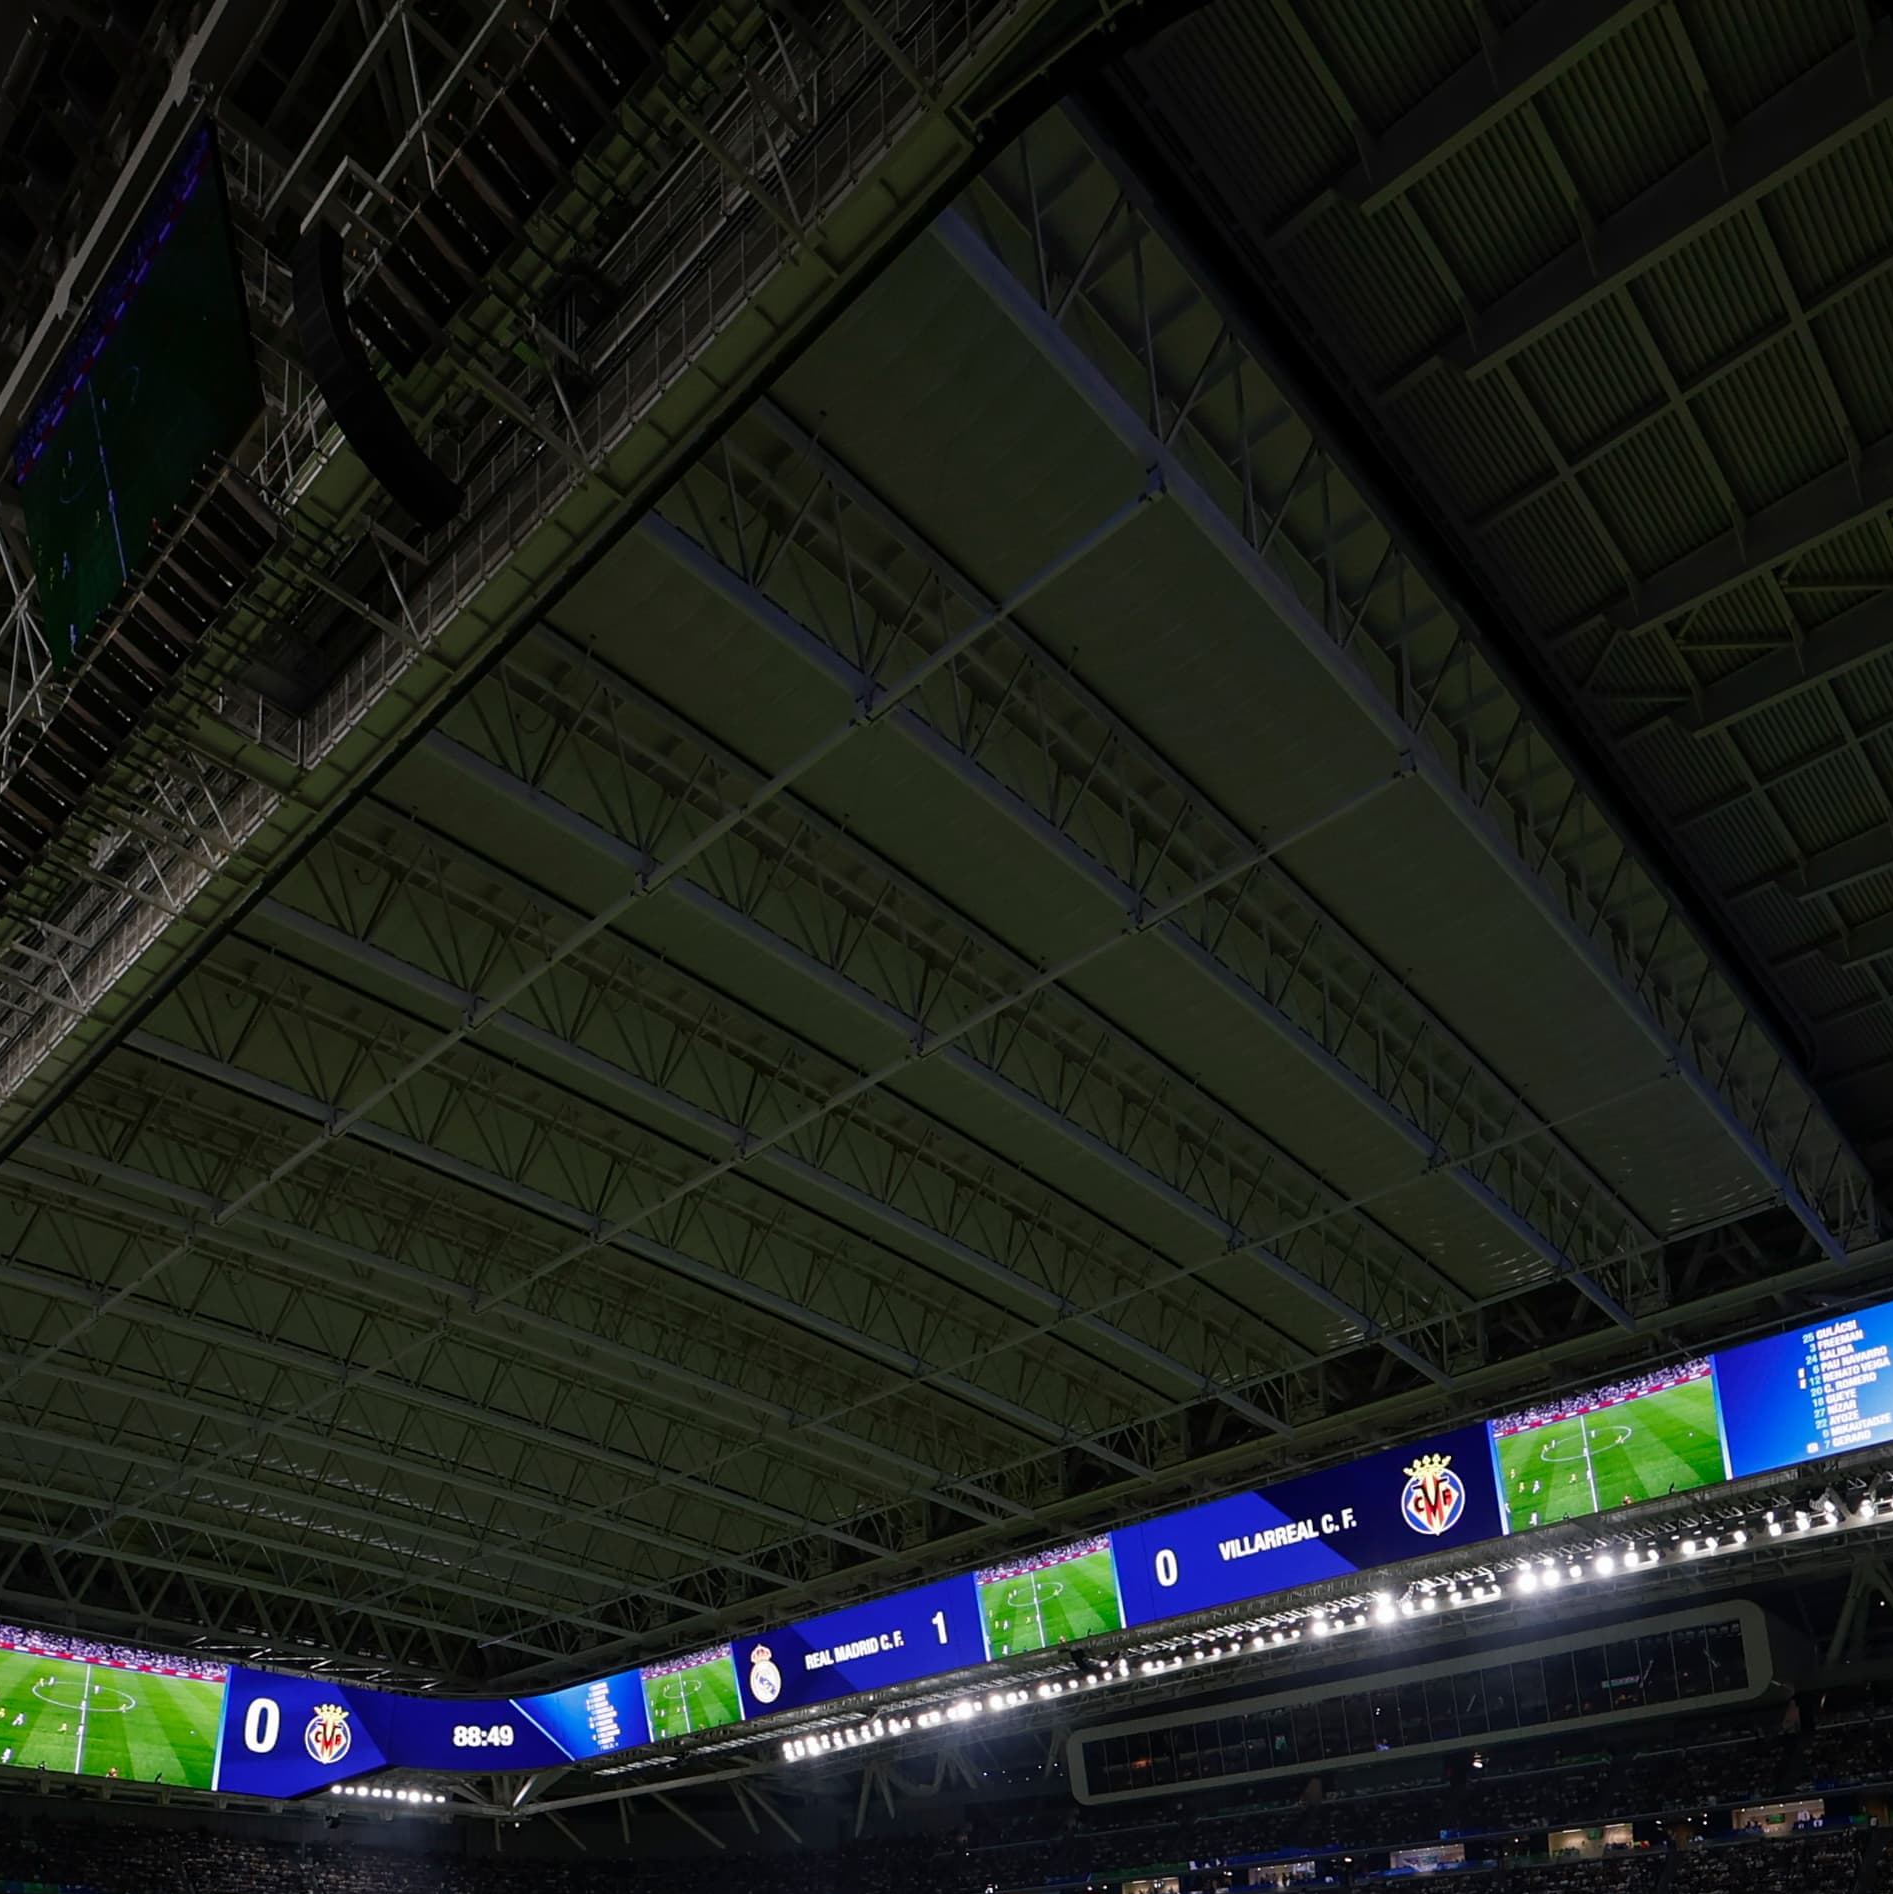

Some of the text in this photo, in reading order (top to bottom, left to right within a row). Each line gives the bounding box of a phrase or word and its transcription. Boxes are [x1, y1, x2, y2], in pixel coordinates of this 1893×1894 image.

[1155, 1508, 1357, 1587] 0 VILLARREAL C. F.
[804, 1649, 834, 1670] REAL
[834, 1637, 879, 1663] MADRID
[932, 1610, 948, 1644] 1
[244, 1697, 280, 1753] 0
[453, 1725, 514, 1746] 88:49
